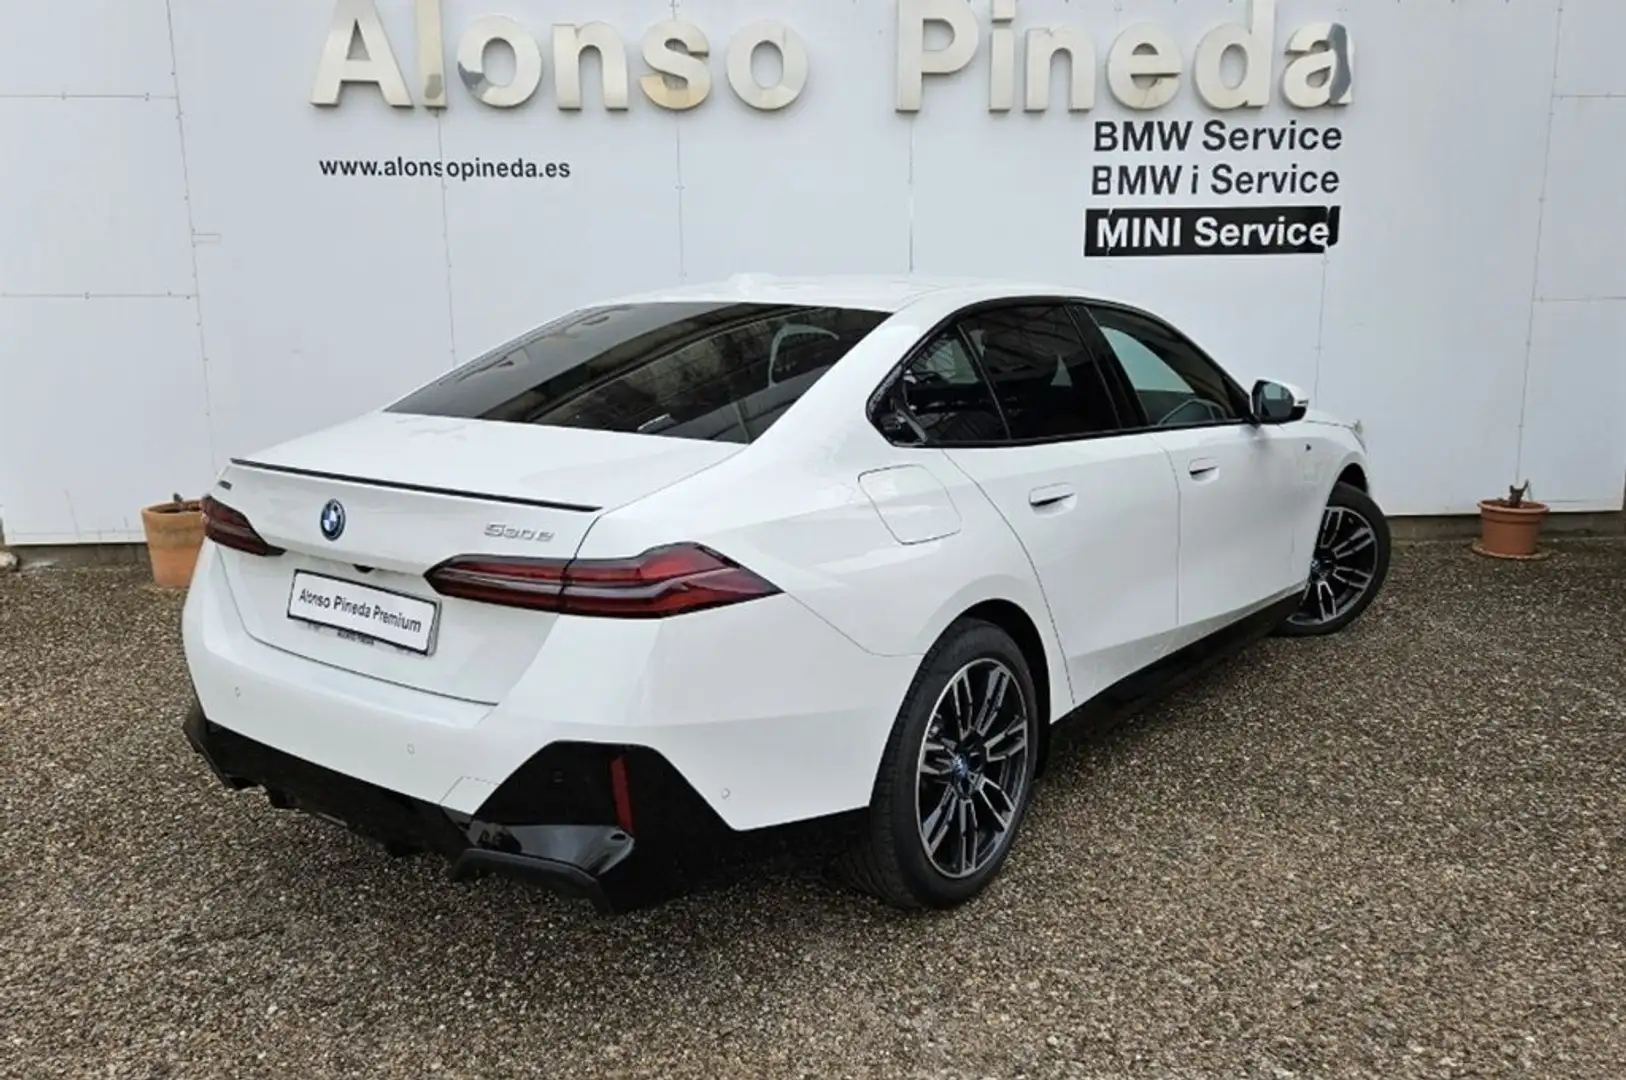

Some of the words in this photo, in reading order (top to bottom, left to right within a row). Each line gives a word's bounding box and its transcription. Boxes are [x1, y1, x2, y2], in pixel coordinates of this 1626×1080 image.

[311, 0, 809, 110] Alonso
[895, 0, 1354, 112] Pineda
[1094, 121, 1194, 152] BMW
[1202, 119, 1342, 151] Service
[319, 157, 571, 181] www.alonsopineda.es
[1092, 165, 1183, 195] BMW
[1190, 165, 1199, 193] i
[1211, 163, 1340, 195] Service
[1096, 217, 1181, 248] MINI
[1194, 214, 1330, 247] Service
[299, 588, 331, 609] Alonso
[333, 595, 372, 618] Pineda
[373, 605, 422, 633] Premium
